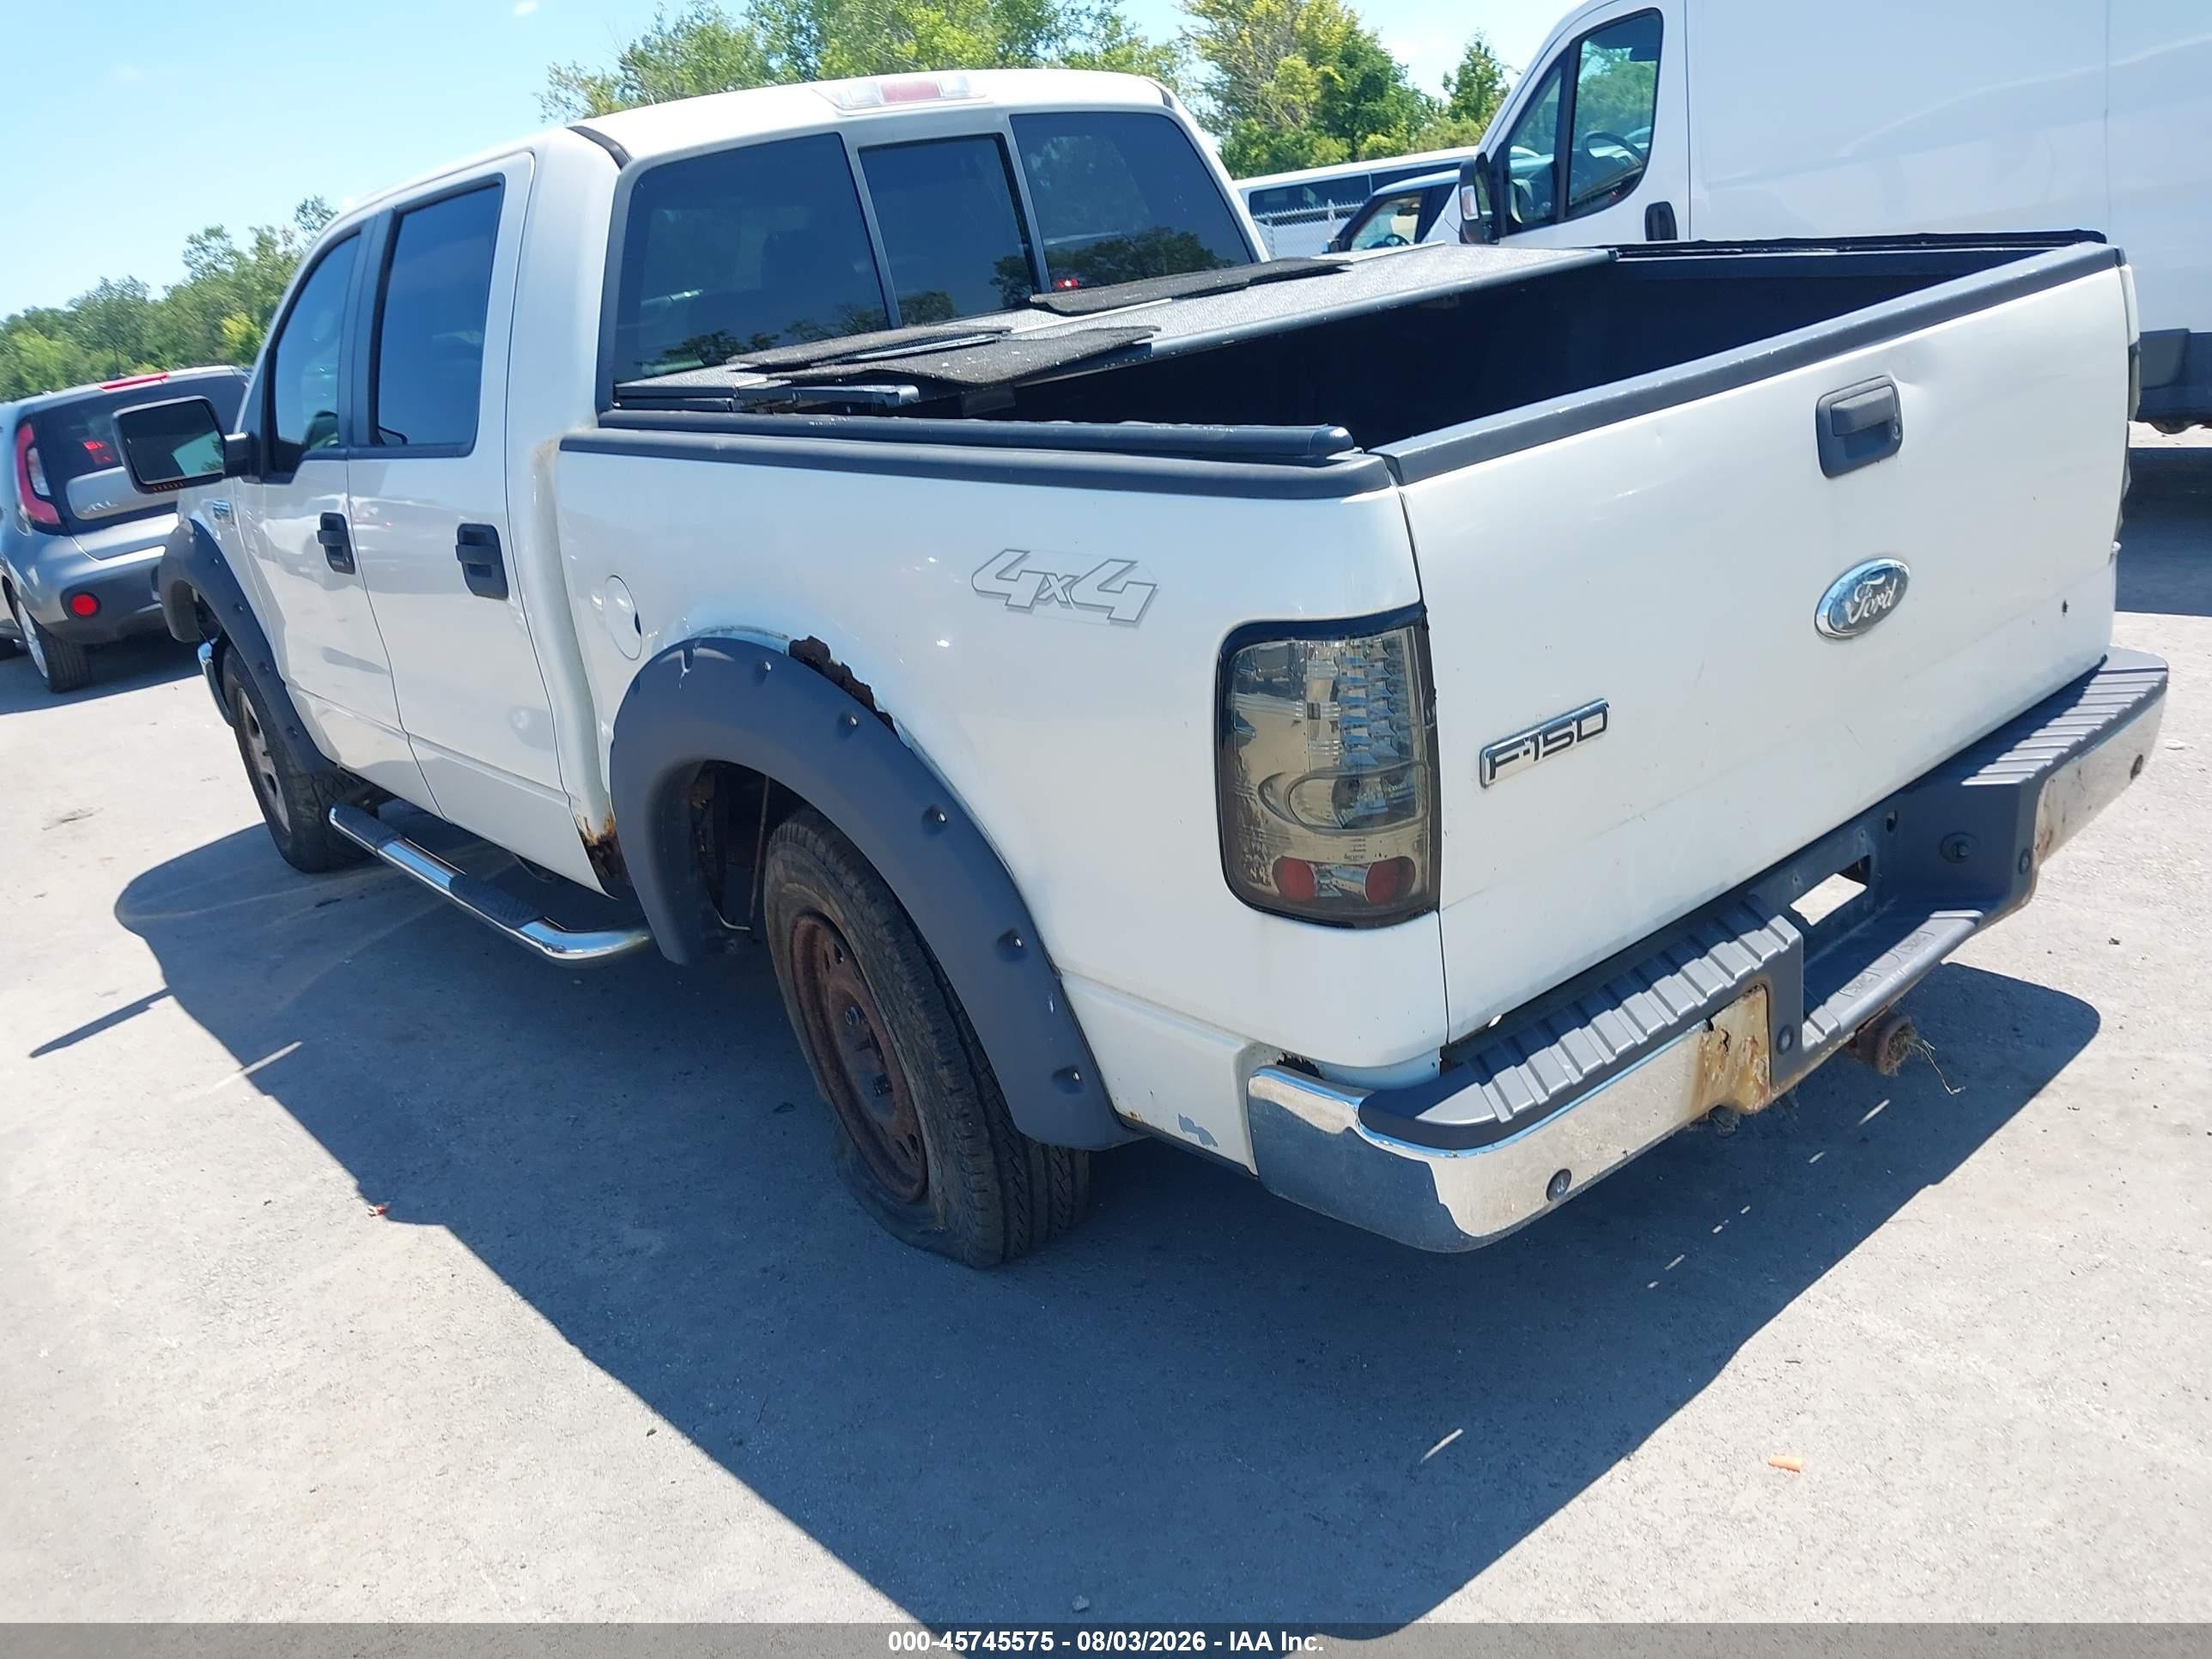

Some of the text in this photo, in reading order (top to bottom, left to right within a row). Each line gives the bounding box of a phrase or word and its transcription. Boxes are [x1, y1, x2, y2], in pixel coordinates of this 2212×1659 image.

[971, 549, 1158, 628] 4x4
[1844, 574, 1899, 625] Ford
[1484, 701, 1609, 782] F-150
